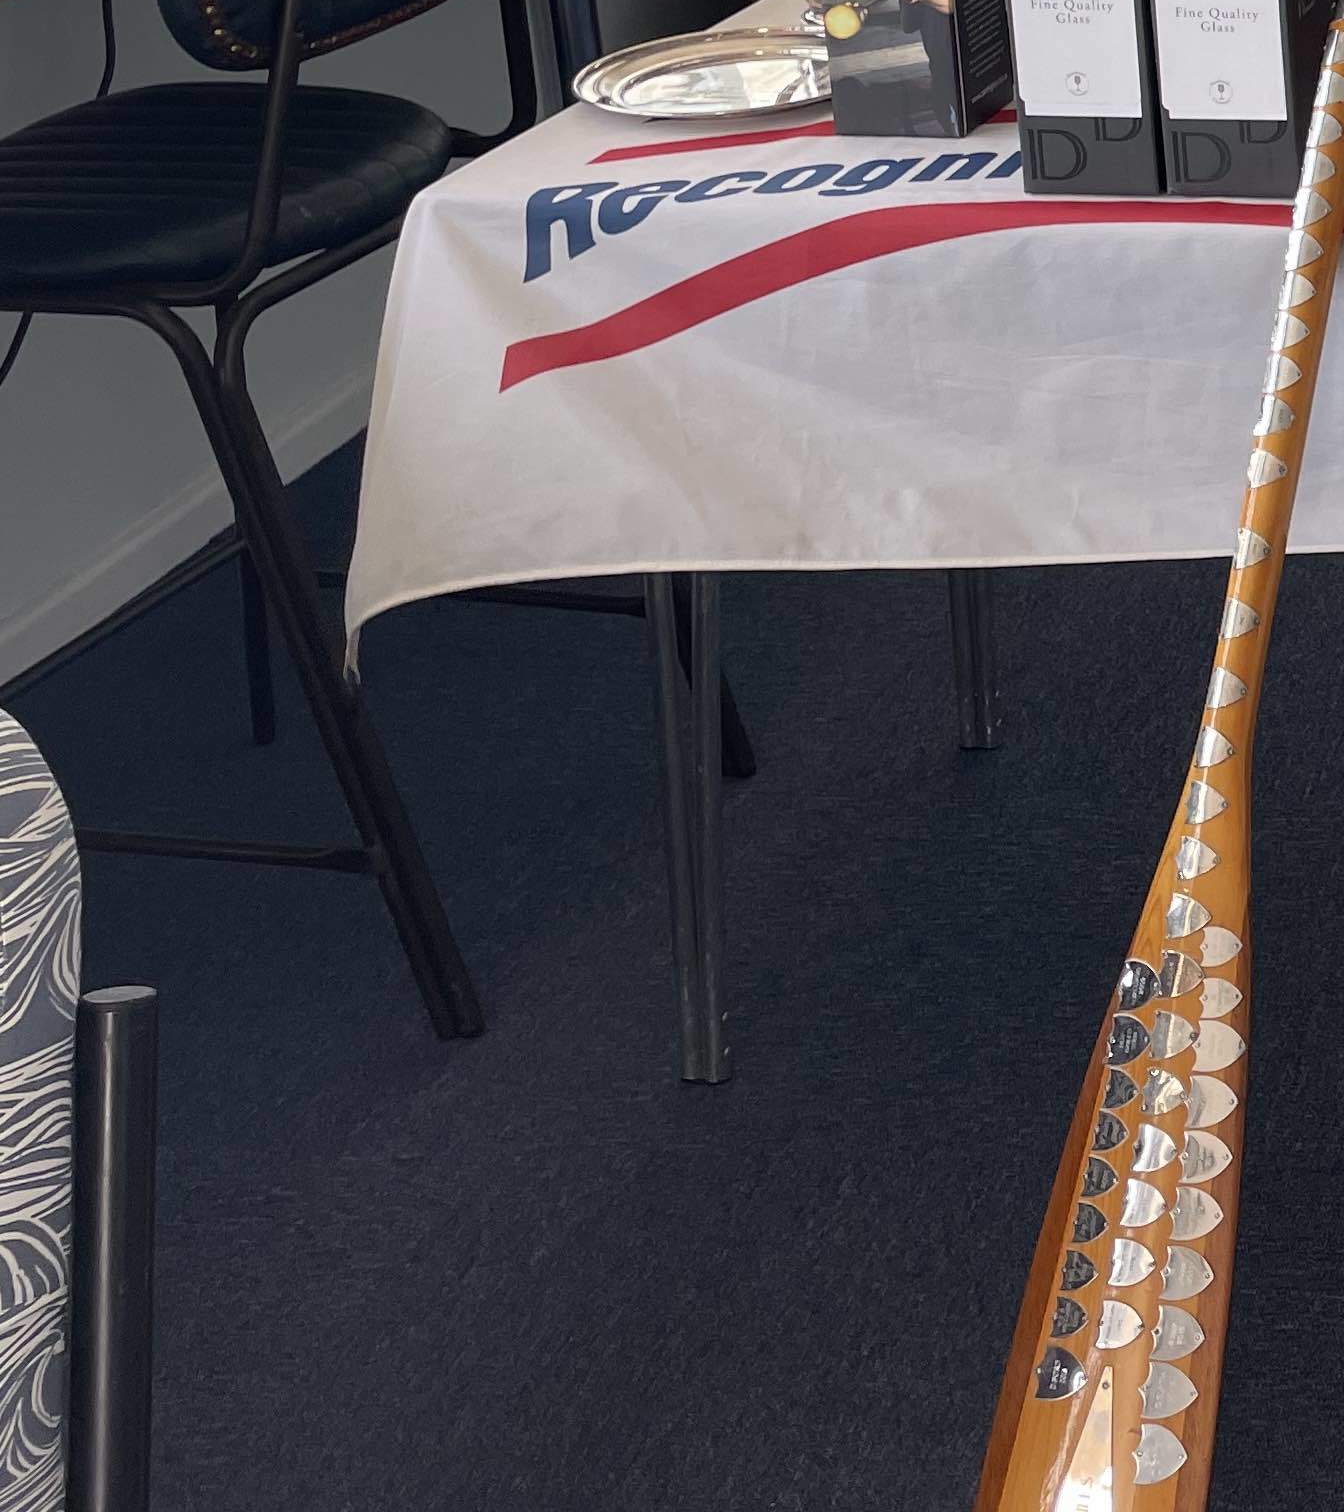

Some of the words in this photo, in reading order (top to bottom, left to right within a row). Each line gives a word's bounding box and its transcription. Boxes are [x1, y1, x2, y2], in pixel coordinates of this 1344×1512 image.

[1055, 12, 1091, 25] Glass
[1175, 7, 1204, 20] Fine
[1209, 7, 1259, 23] Quality
[1200, 20, 1236, 33] Glass
[523, 150, 1022, 285] Recogni
